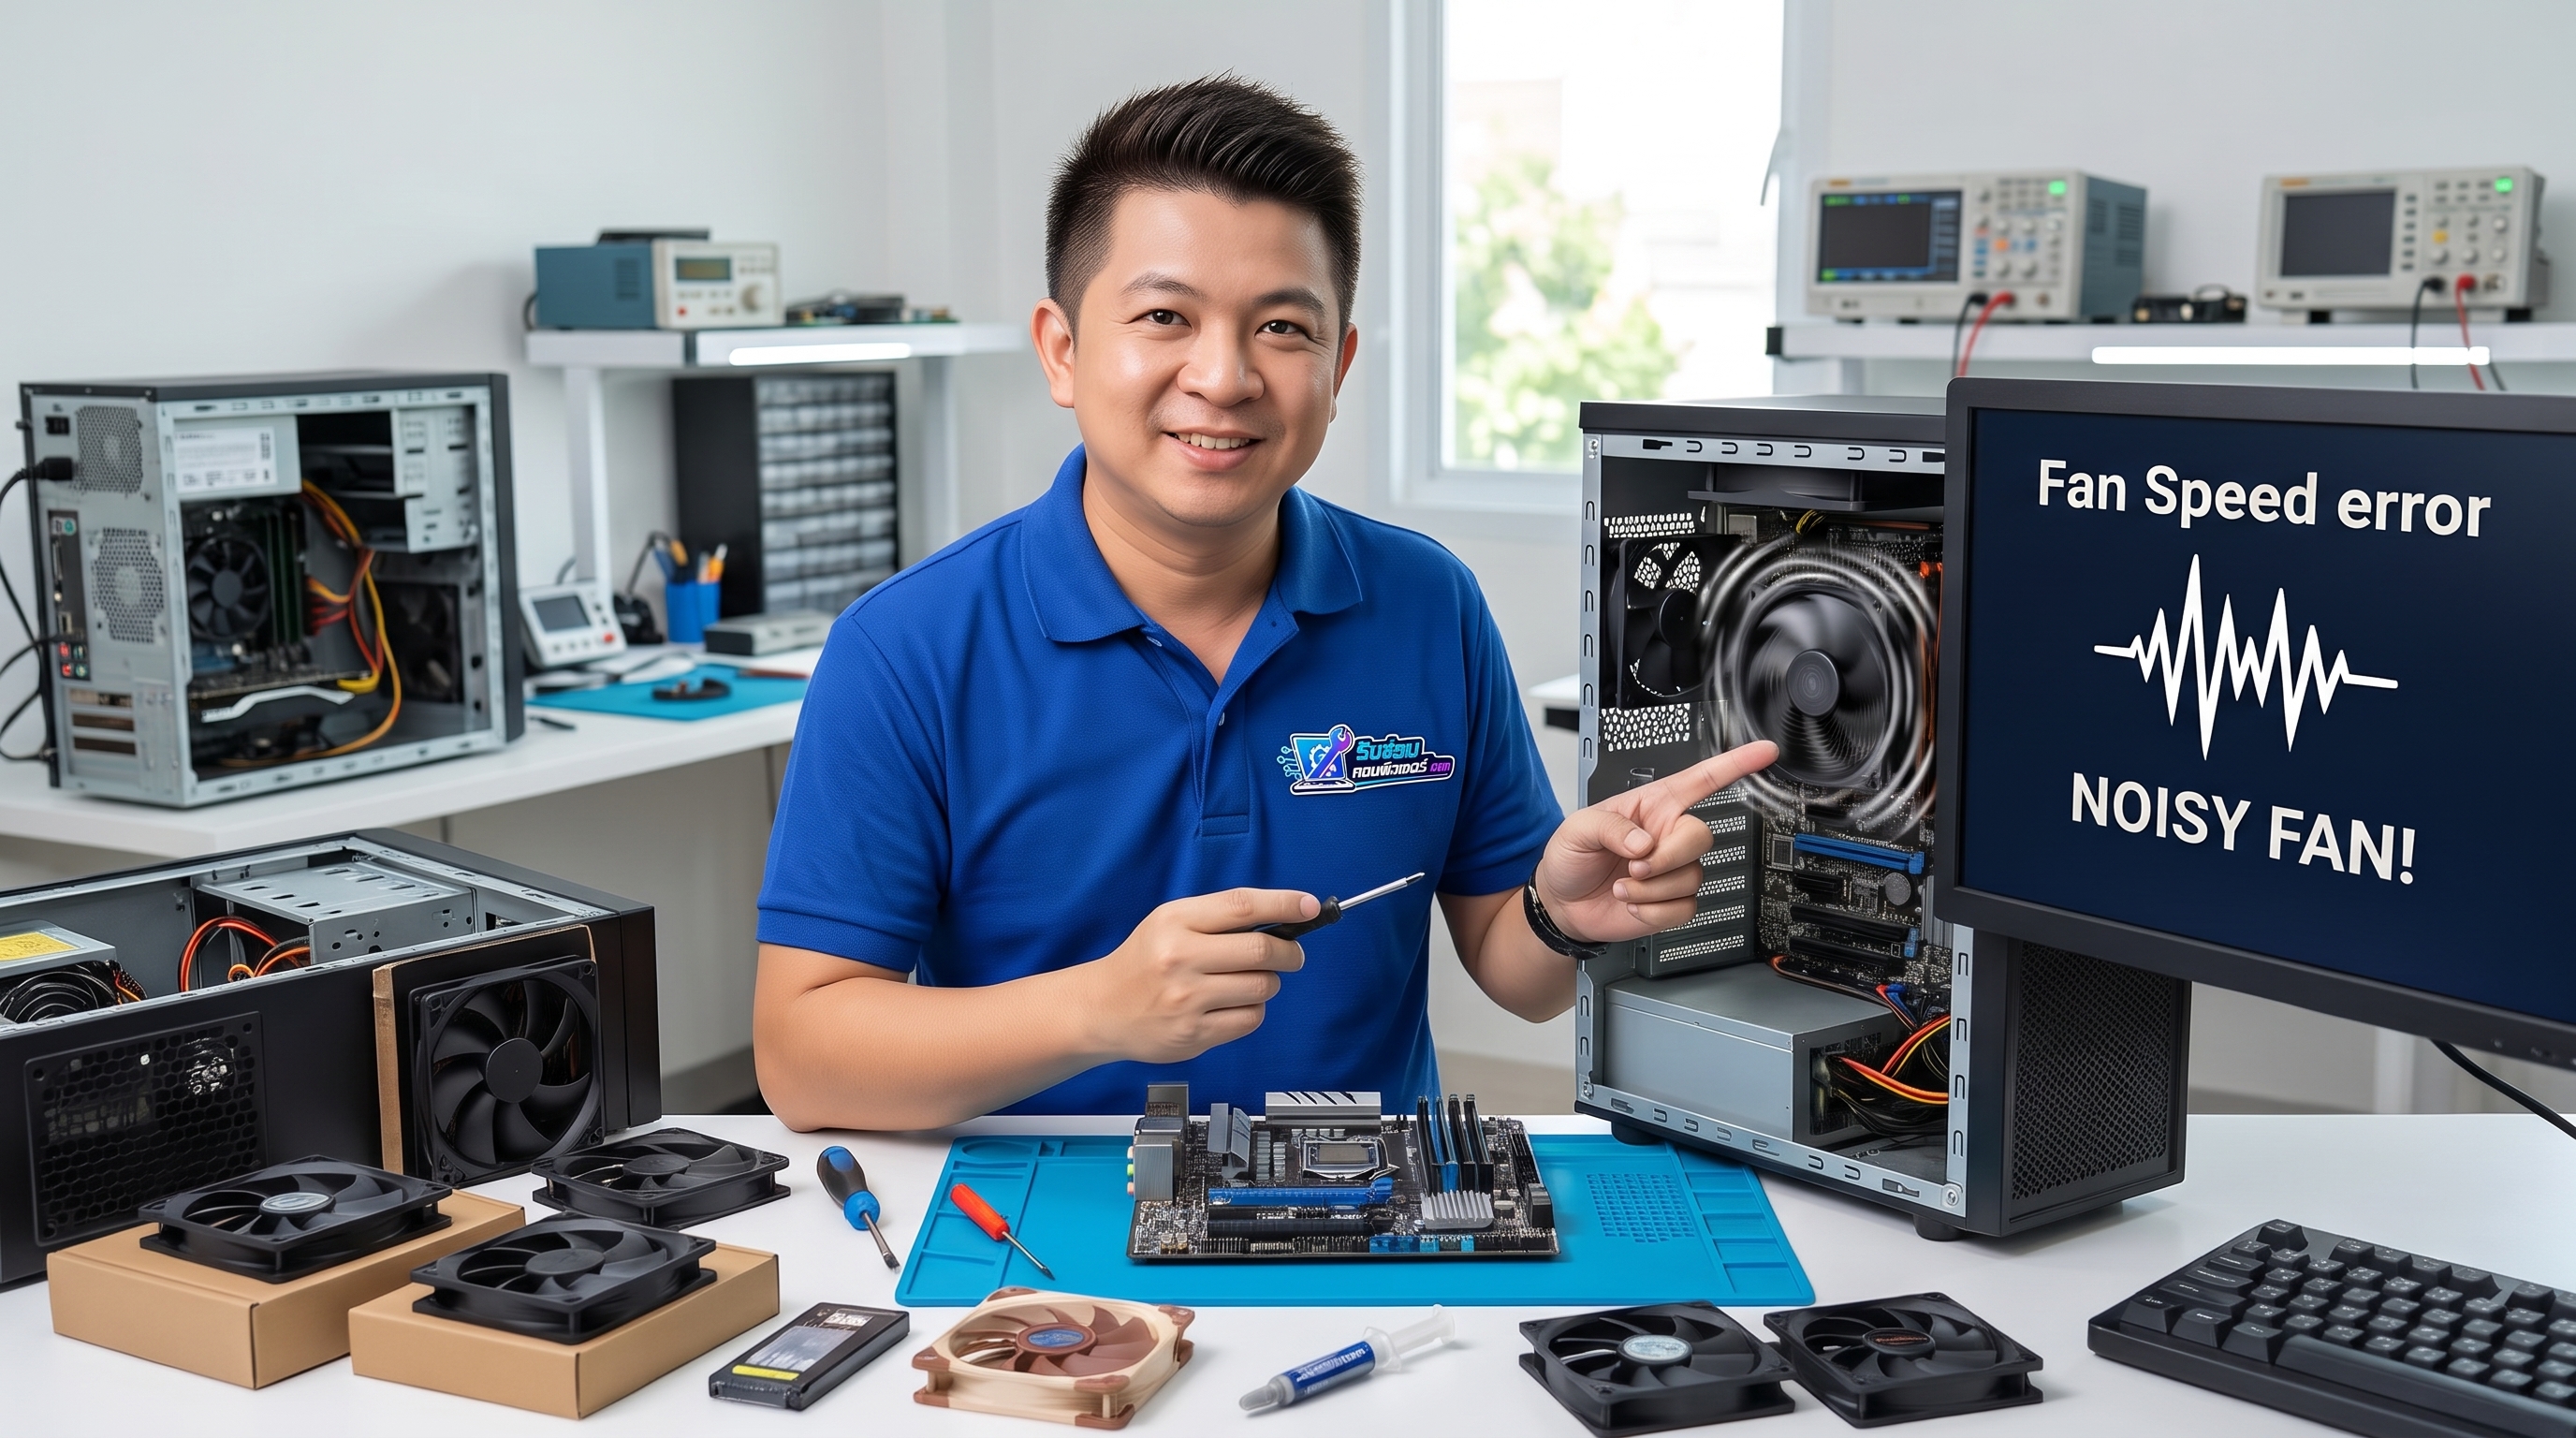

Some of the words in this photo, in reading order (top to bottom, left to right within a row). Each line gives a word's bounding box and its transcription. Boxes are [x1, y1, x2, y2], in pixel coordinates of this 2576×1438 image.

[2039, 459, 2127, 512] Fan
[2144, 464, 2318, 529] Speed
[2337, 489, 2492, 537] error
[2071, 771, 2252, 851] NOISY
[2268, 805, 2416, 885] FAN!
